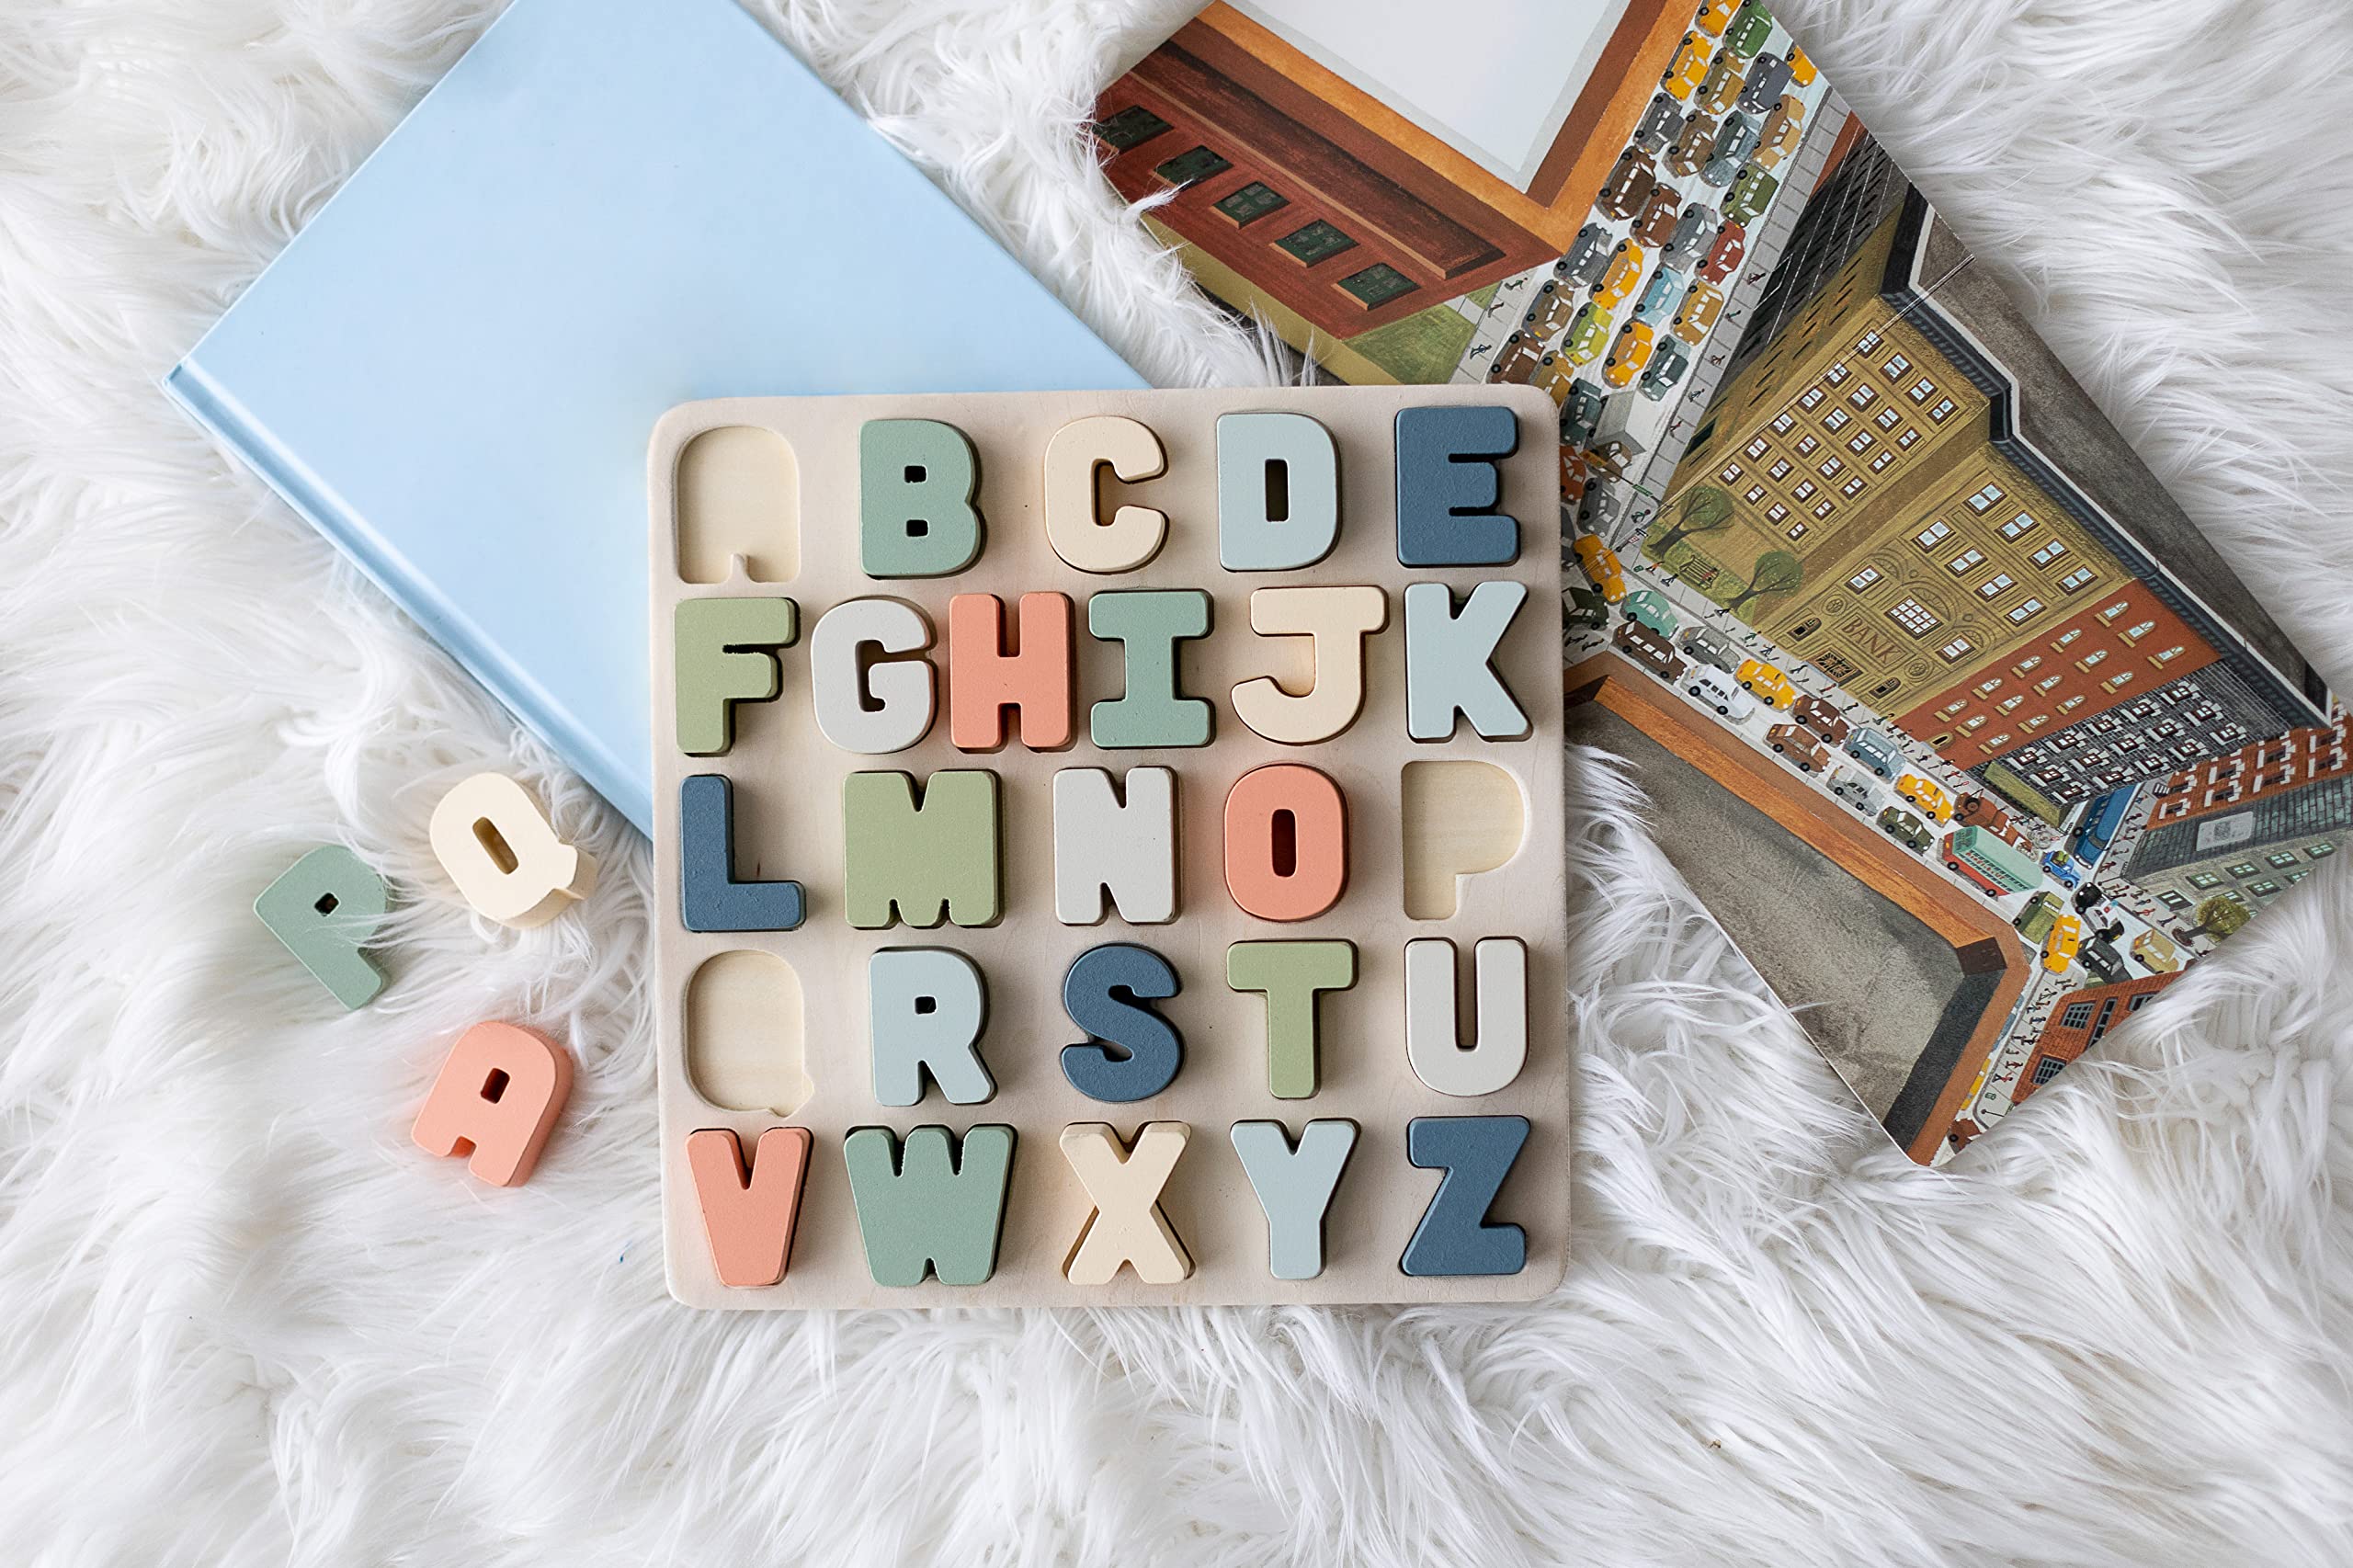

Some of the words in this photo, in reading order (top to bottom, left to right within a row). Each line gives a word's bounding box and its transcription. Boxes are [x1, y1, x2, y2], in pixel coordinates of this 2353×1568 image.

[858, 418, 982, 578] B
[1044, 415, 1166, 572] C
[1216, 413, 1340, 570] D
[1395, 406, 1518, 565] E
[675, 597, 798, 756] F
[811, 597, 936, 755] G
[949, 592, 1074, 750] H
[1088, 590, 1211, 747] I
[1231, 586, 1387, 744] J
[1405, 581, 1531, 741] K
[1841, 616, 1903, 664] BANK
[254, 846, 386, 1011] P
[429, 772, 597, 929] Q
[680, 774, 806, 931] L
[843, 769, 1002, 928] M
[1053, 767, 1179, 925] N
[1224, 763, 1349, 922] O
[411, 1021, 574, 1187] A
[870, 948, 997, 1107] R
[1061, 945, 1183, 1102] S
[1227, 939, 1357, 1099] T
[1404, 937, 1529, 1097] U
[687, 1127, 813, 1288] V
[843, 1124, 1016, 1287] W
[1060, 1121, 1194, 1285] X
[1230, 1119, 1360, 1280] Y
[1400, 1117, 1530, 1276] Z
